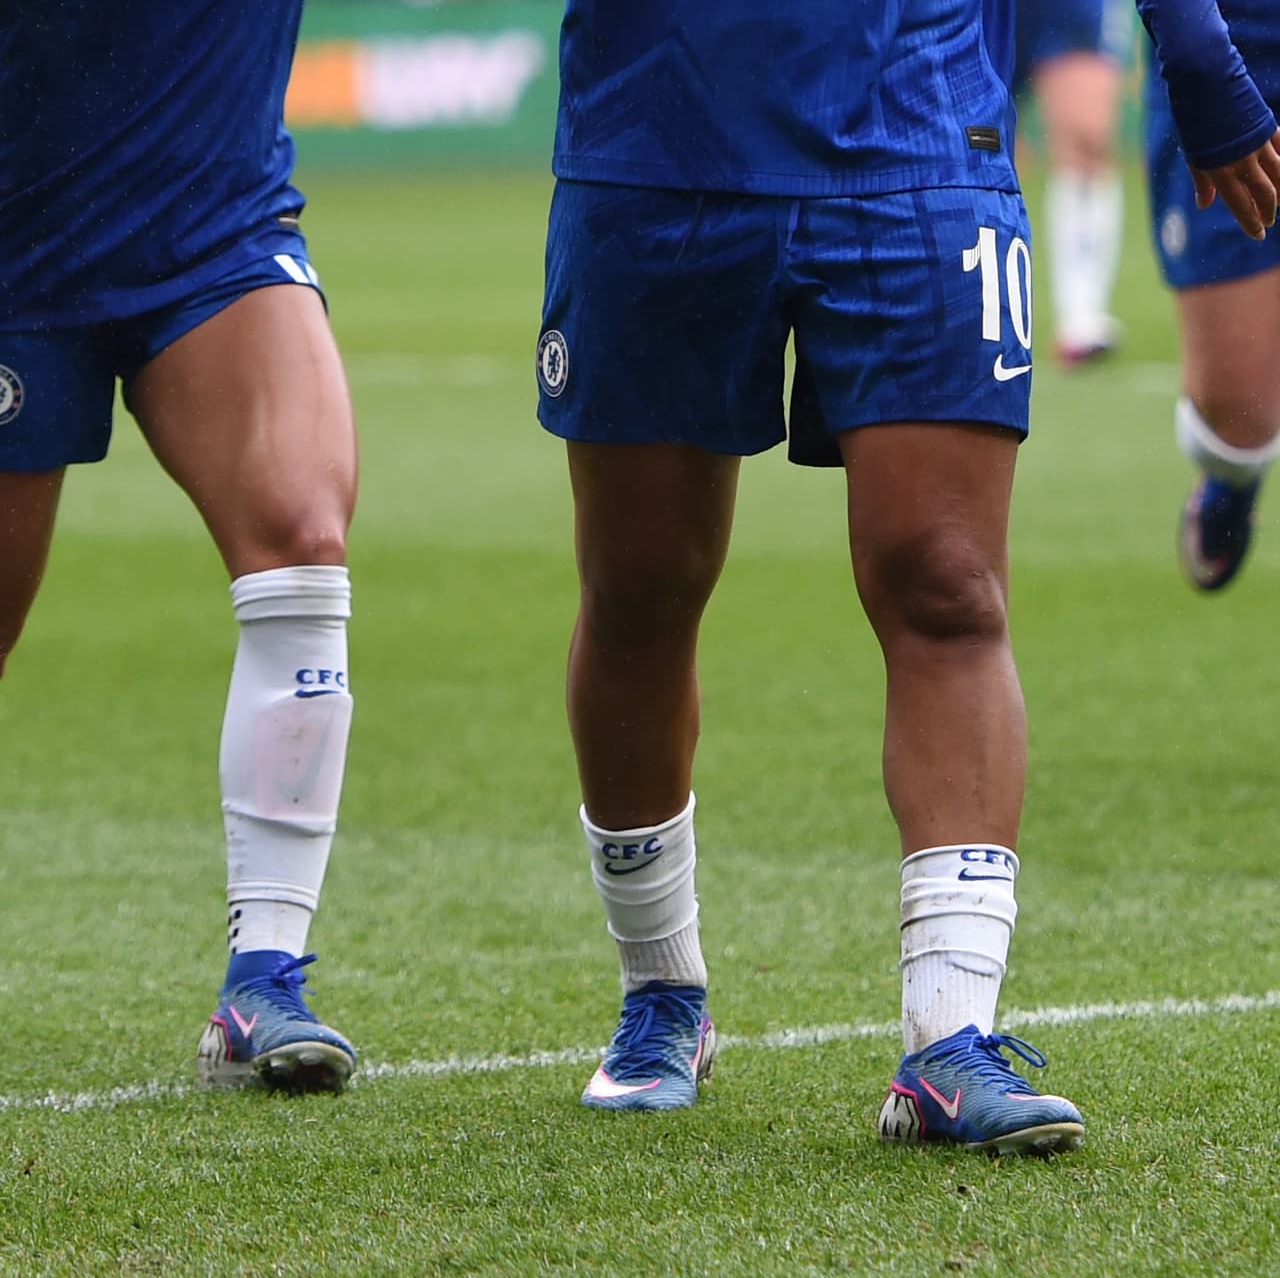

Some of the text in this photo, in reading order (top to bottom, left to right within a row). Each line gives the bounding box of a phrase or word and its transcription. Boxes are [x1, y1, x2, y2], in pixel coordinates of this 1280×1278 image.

[962, 225, 1032, 350] 10
[296, 668, 345, 688] CFC
[602, 837, 664, 860] CFC
